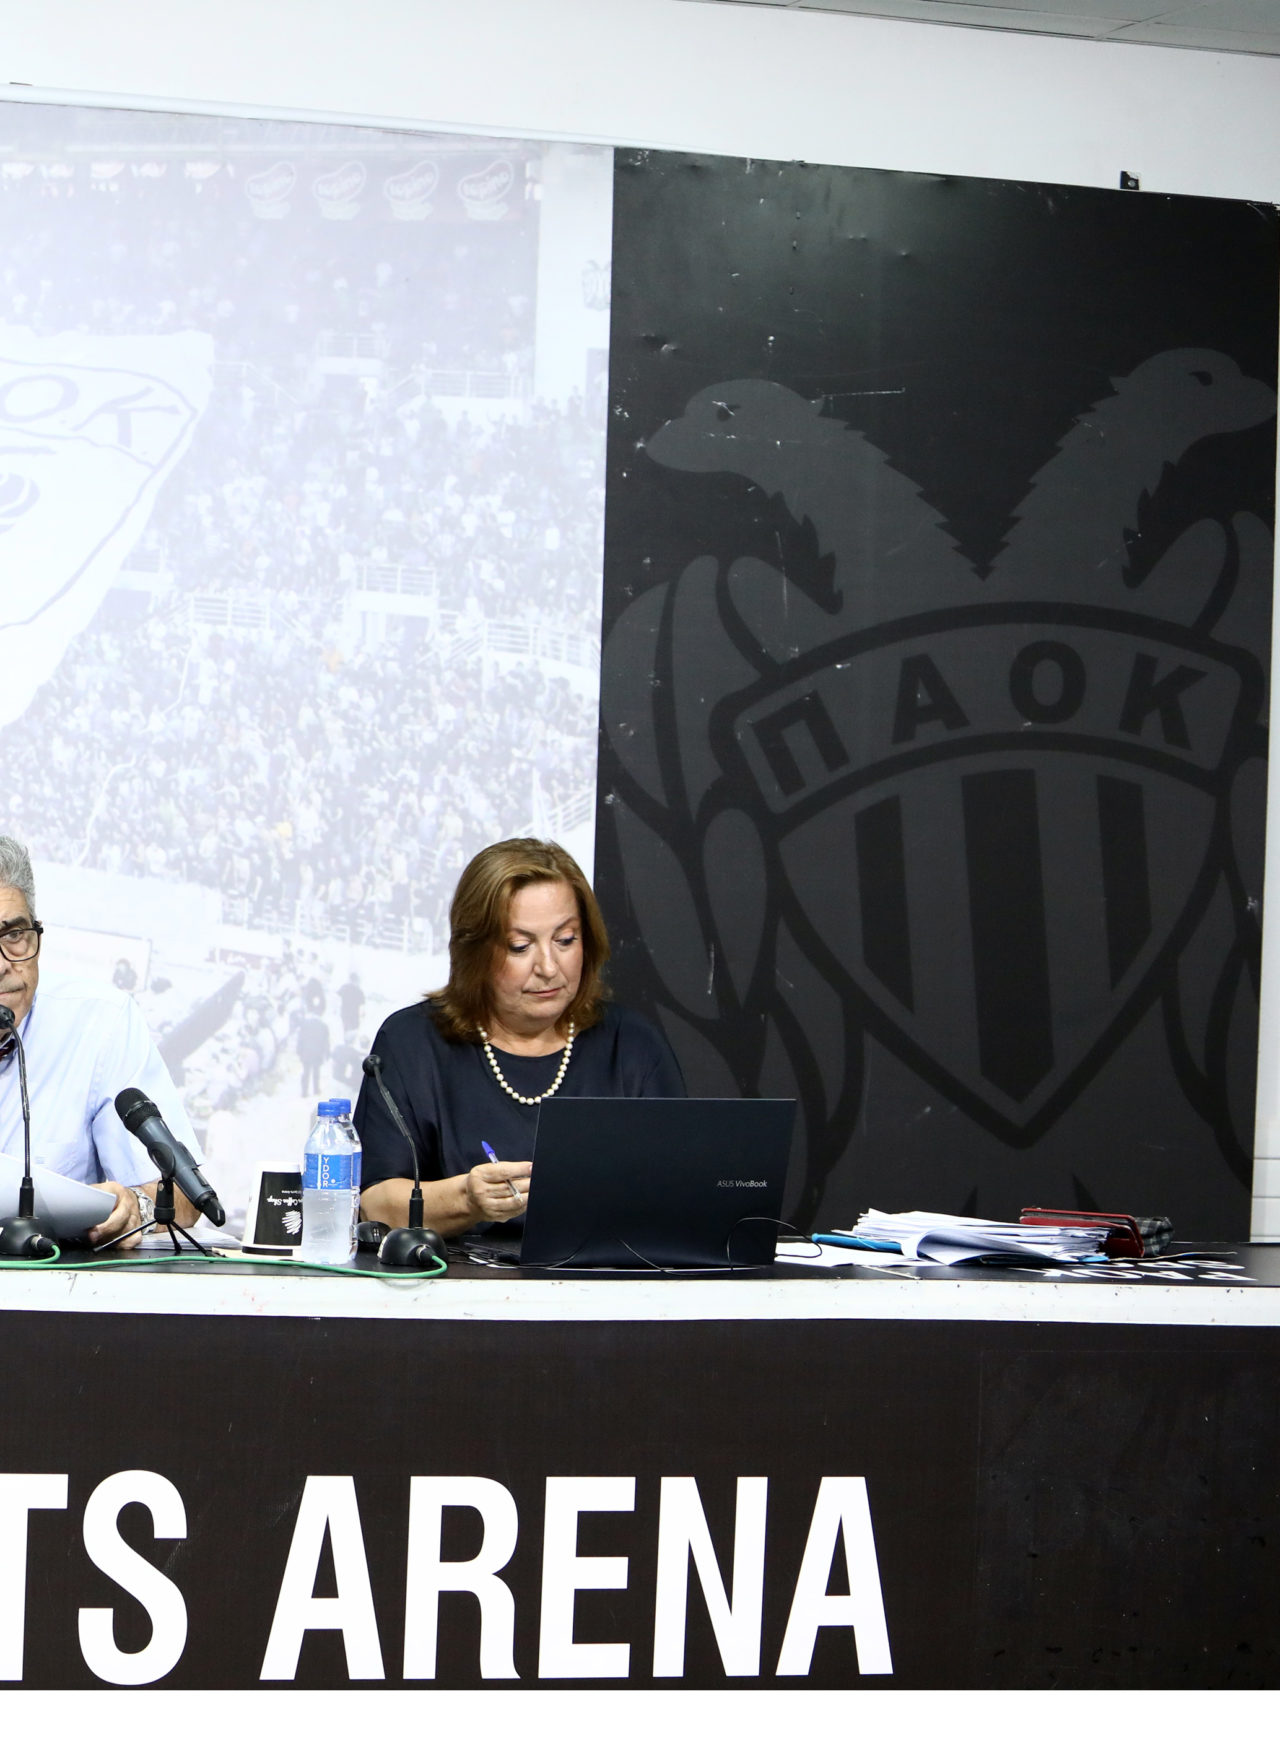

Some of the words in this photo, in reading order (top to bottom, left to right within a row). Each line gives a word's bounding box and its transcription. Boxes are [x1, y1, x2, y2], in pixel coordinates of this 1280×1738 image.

[753, 639, 1208, 798] ΠΑΟΚ
[717, 1180, 735, 1188] ASUS
[735, 1180, 768, 1188] VivoBook
[260, 1476, 893, 1680] ARENA
